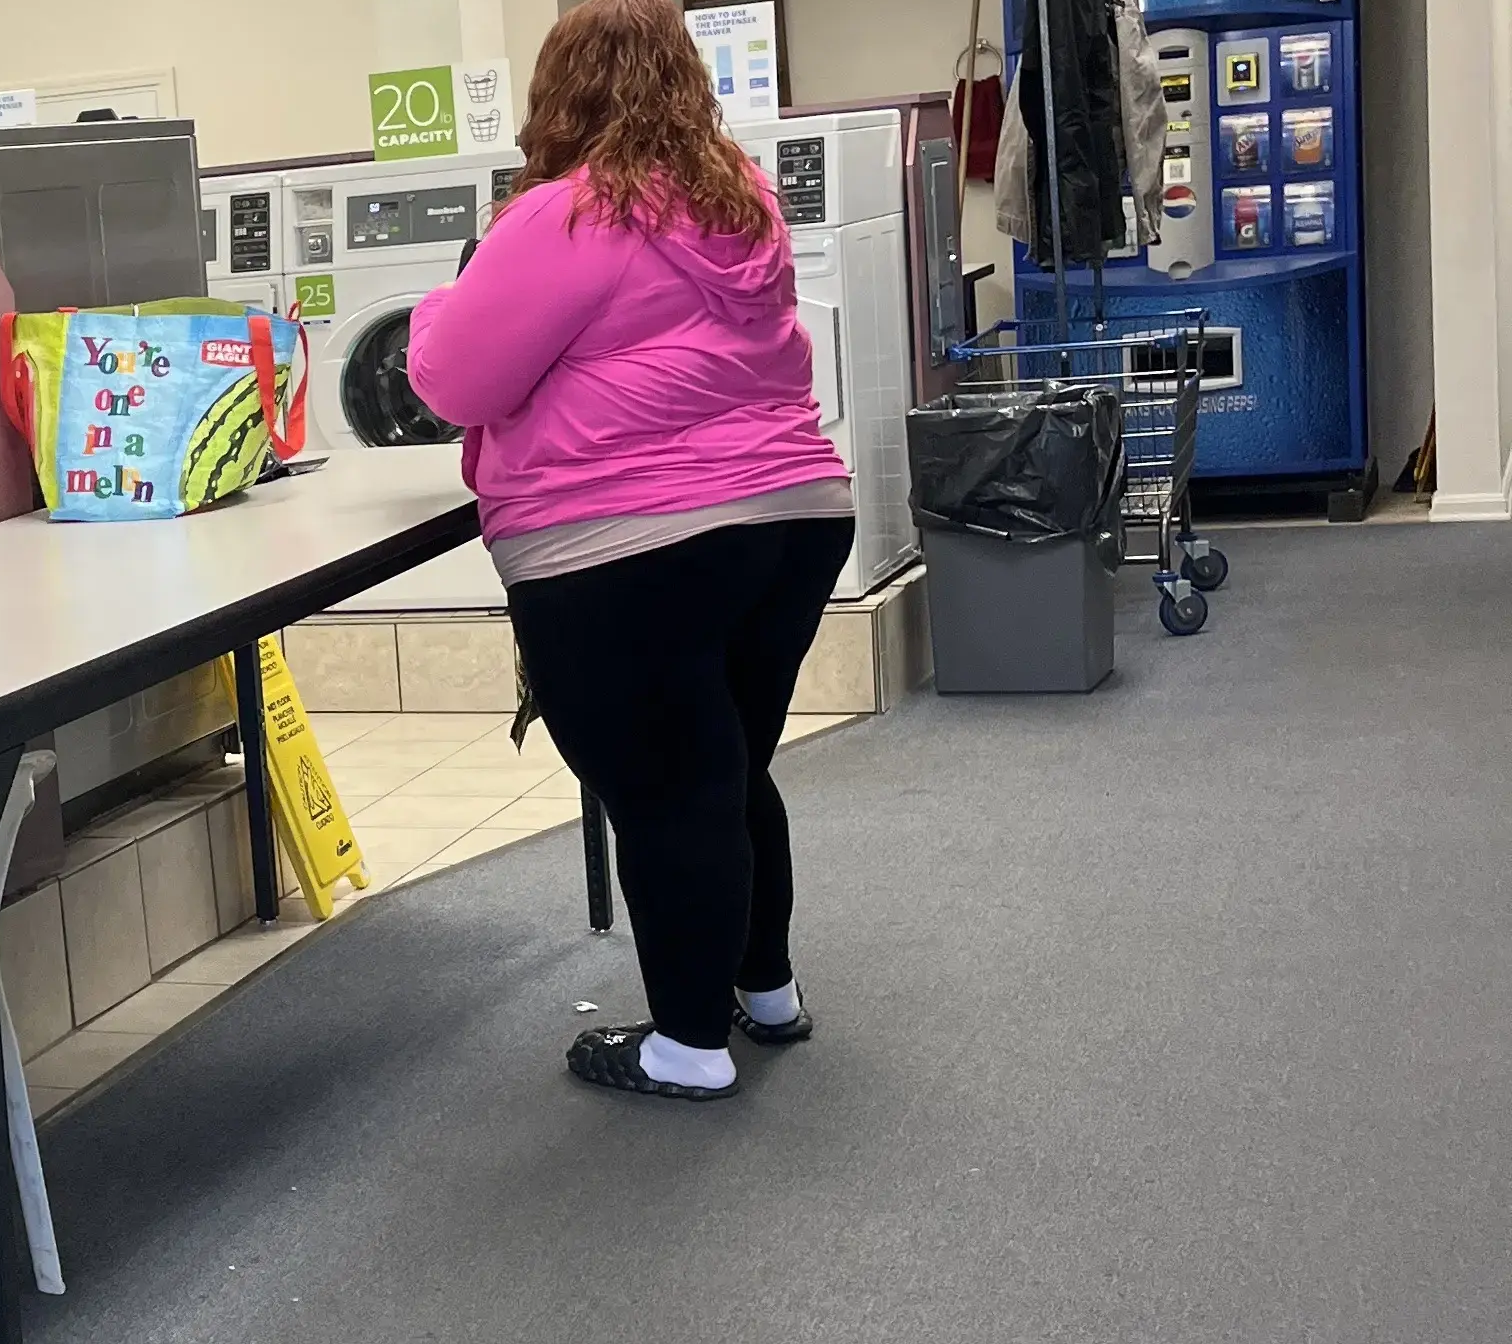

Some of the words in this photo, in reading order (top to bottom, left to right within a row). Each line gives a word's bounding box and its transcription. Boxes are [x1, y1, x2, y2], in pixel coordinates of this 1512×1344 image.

[695, 12, 717, 22] HOW
[718, 11, 730, 19] TO
[732, 9, 747, 17] USE
[695, 21, 711, 30] THE
[713, 16, 757, 28] DISPENSER
[695, 27, 732, 37] DRAWER
[374, 81, 439, 131] 20
[440, 110, 453, 124] lb
[378, 128, 453, 147] CAPACITY
[1240, 224, 1254, 238] G
[299, 284, 331, 307] 25
[81, 336, 171, 378] You're
[206, 343, 251, 355] GIANT
[206, 352, 250, 364] EAGLE
[94, 384, 146, 416] one
[82, 424, 113, 456] in
[124, 433, 145, 457] a
[66, 464, 154, 503] melon
